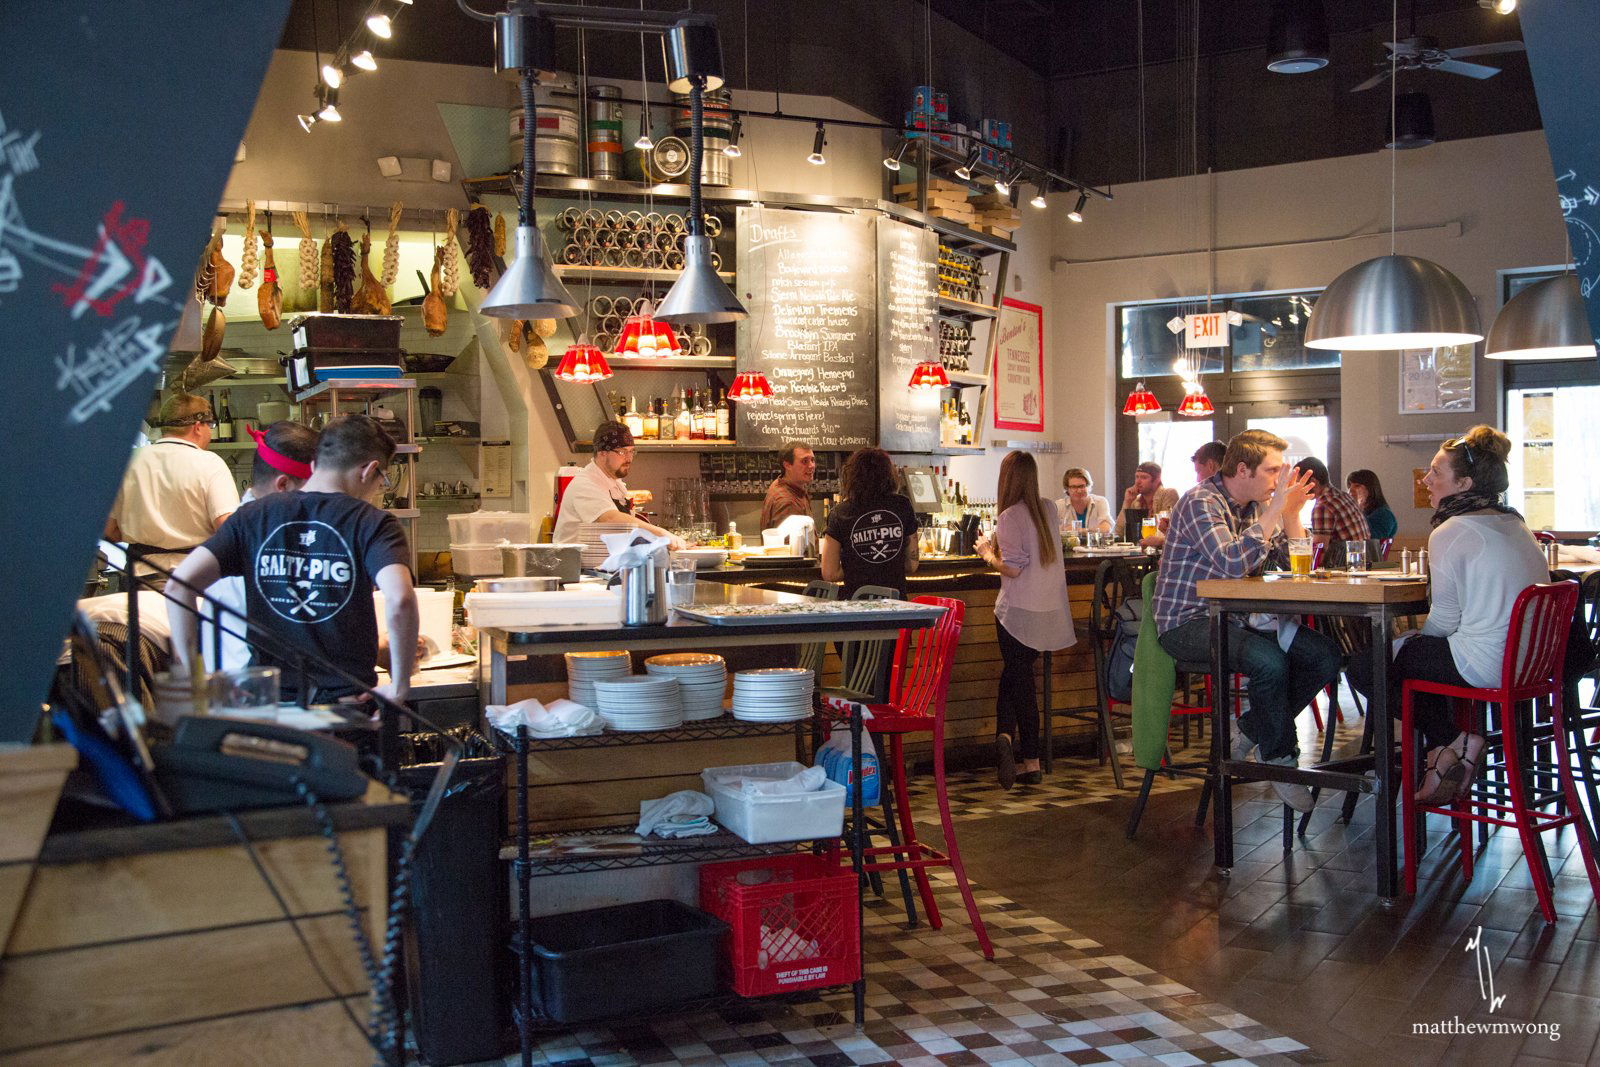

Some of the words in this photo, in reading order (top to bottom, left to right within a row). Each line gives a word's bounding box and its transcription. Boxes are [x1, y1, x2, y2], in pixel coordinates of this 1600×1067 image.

[749, 223, 797, 243] Drafts
[772, 303, 815, 316] Delirium
[817, 303, 858, 317] Tremens
[827, 315, 850, 327] house
[1194, 315, 1220, 337] EXIT
[774, 324, 819, 342] Brooklyn
[820, 326, 857, 341] Summer
[823, 340, 838, 351] IPA
[823, 352, 855, 364] Bastard
[1007, 348, 1030, 363] TENNESSEE
[817, 367, 855, 381] Hennepin
[789, 380, 819, 395] Republic
[774, 411, 797, 427] spring
[797, 411, 805, 421] is
[853, 528, 878, 544] SALTY
[880, 526, 902, 539] PIG
[260, 554, 305, 578] SALTY
[308, 558, 351, 583] PIG
[776, 971, 790, 979] THEFT
[791, 969, 798, 977] OF
